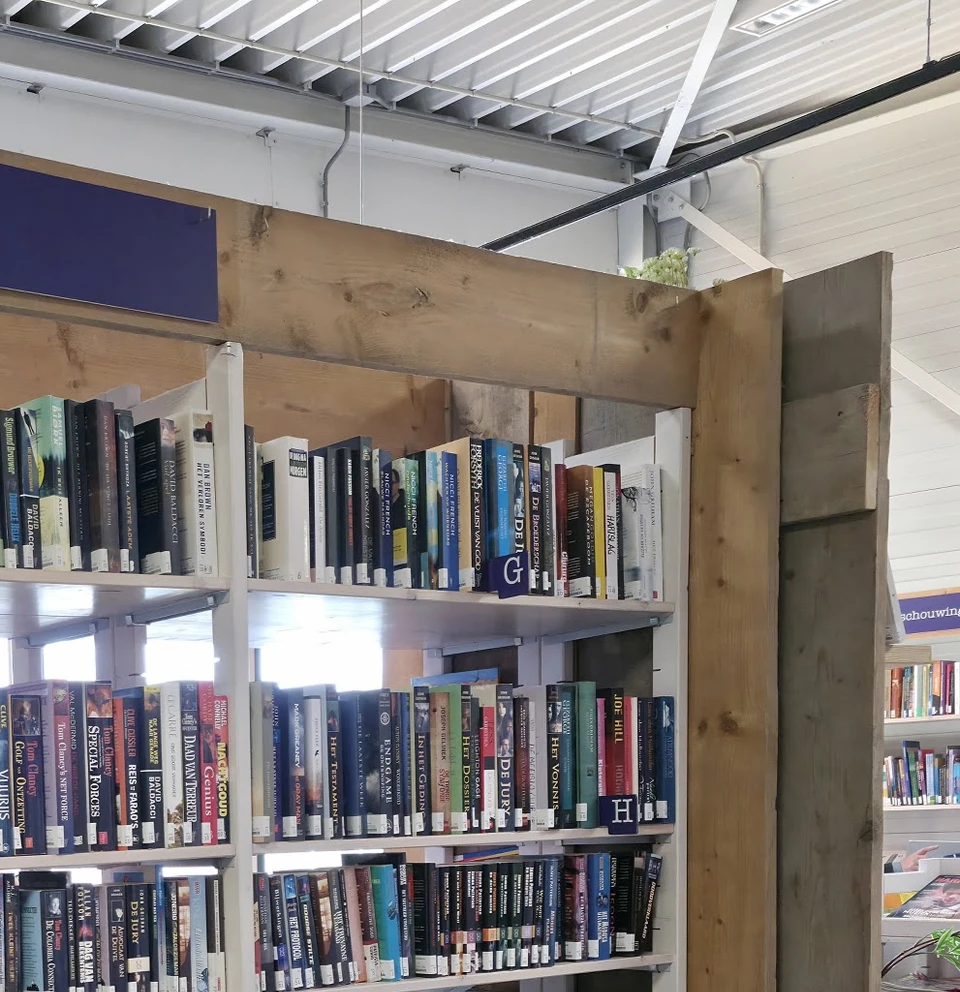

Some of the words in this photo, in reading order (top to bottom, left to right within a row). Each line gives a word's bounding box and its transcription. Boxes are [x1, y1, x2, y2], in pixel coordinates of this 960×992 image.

[606, 514, 616, 556] HARTSLAG
[503, 555, 525, 586] G
[614, 694, 623, 716] JOE
[103, 726, 114, 745] Tom
[614, 719, 624, 745] HILL
[28, 742, 39, 762] Tom
[87, 726, 101, 772] SPECIAL
[102, 747, 115, 777] Clancy
[183, 736, 198, 761] DAAD
[551, 737, 560, 760] HET
[27, 764, 39, 797] Clancy
[185, 763, 197, 780] VAN
[90, 775, 103, 818] FORCES
[203, 766, 217, 817] Genius
[551, 763, 560, 811] VONNIS
[185, 782, 198, 823] TERREUR
[611, 798, 634, 825] H
[129, 901, 139, 916] DE
[274, 889, 284, 939] Bijwerkingen
[130, 919, 140, 945] JURY
